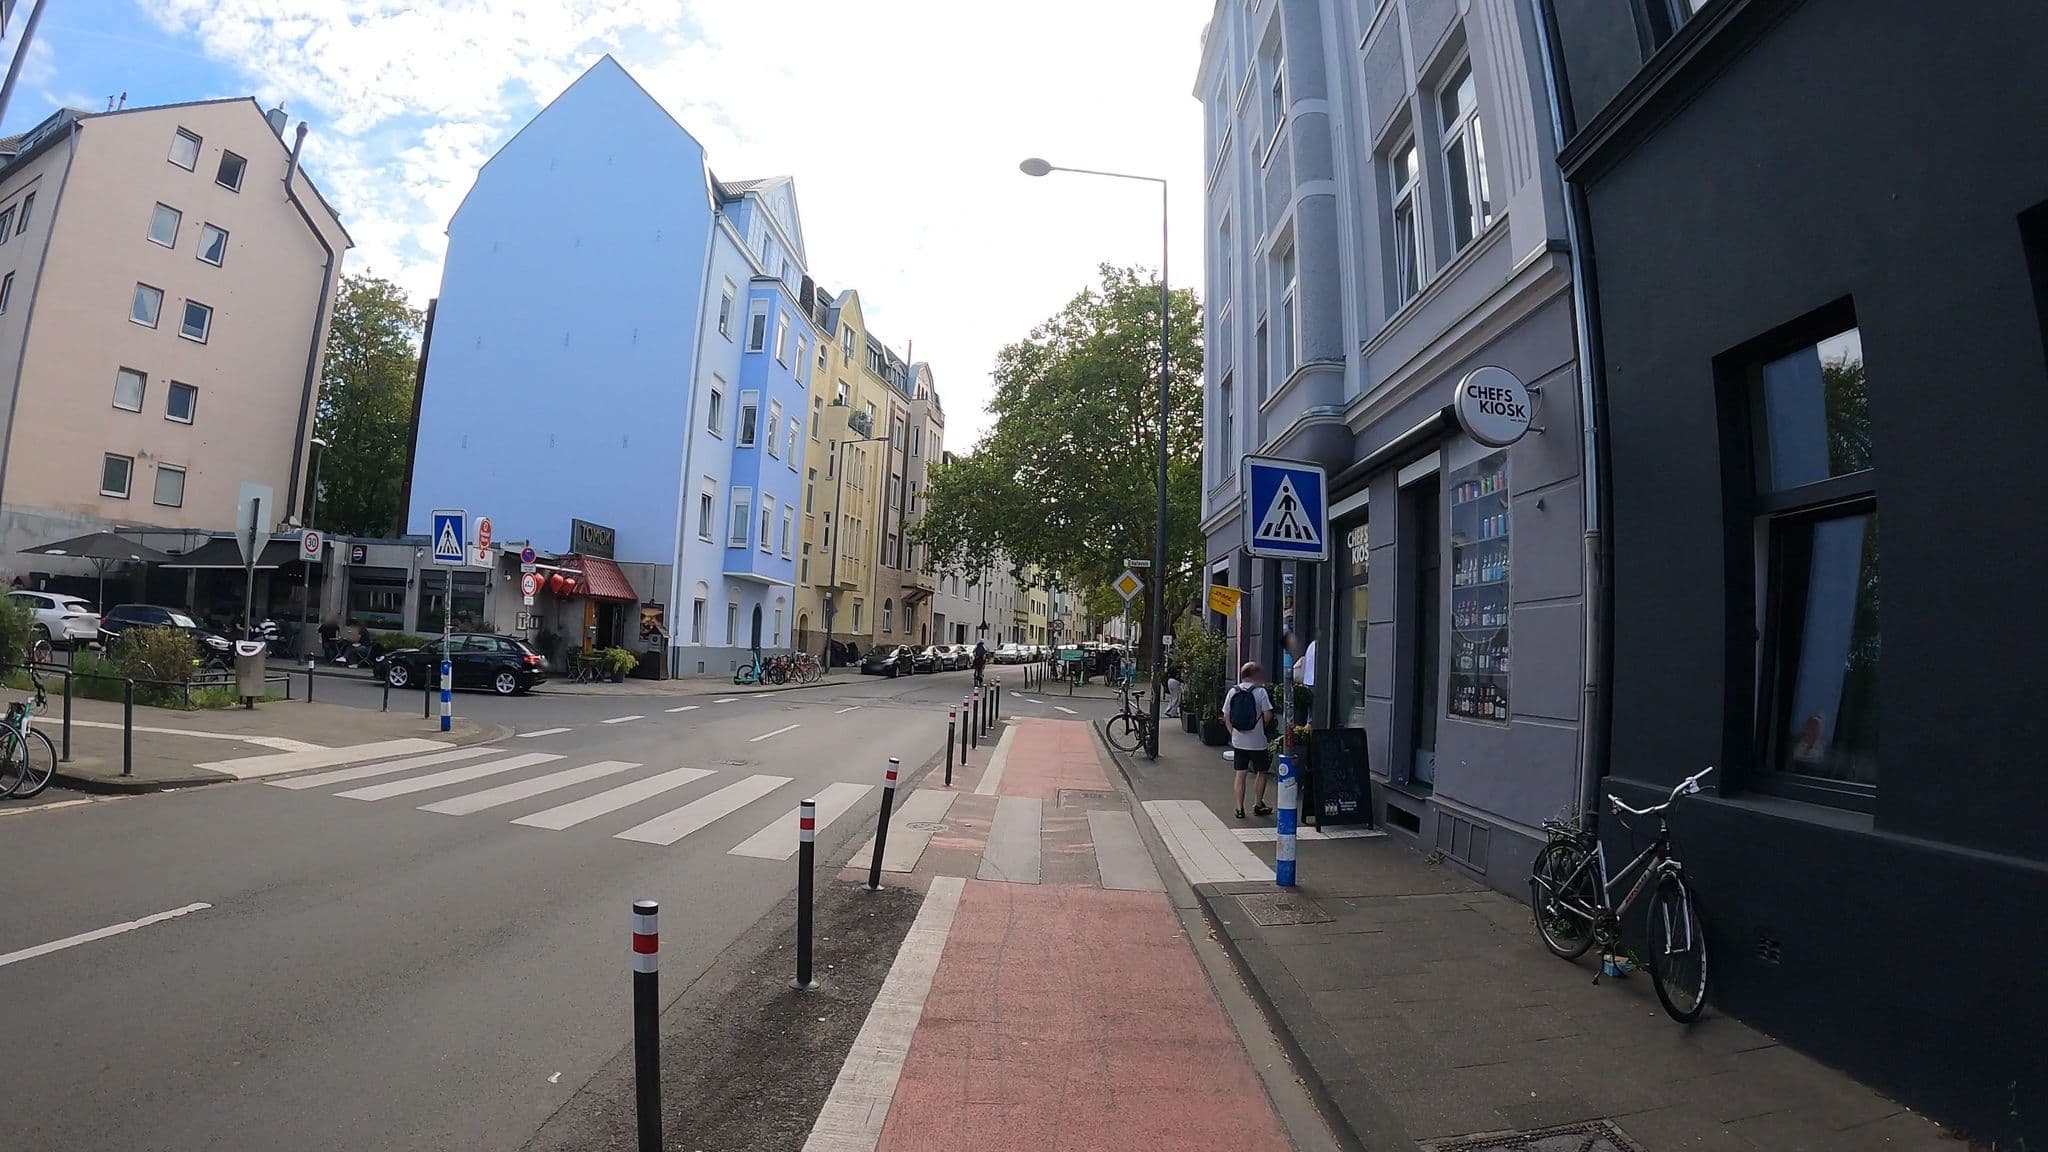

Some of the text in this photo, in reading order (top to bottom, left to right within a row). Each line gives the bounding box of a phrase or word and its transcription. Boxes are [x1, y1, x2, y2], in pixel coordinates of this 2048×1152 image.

[1467, 385, 1513, 402] CHEFS
[1480, 400, 1526, 418] KIOSK
[307, 537, 317, 548] 30
[1347, 526, 1369, 548] CHEFS
